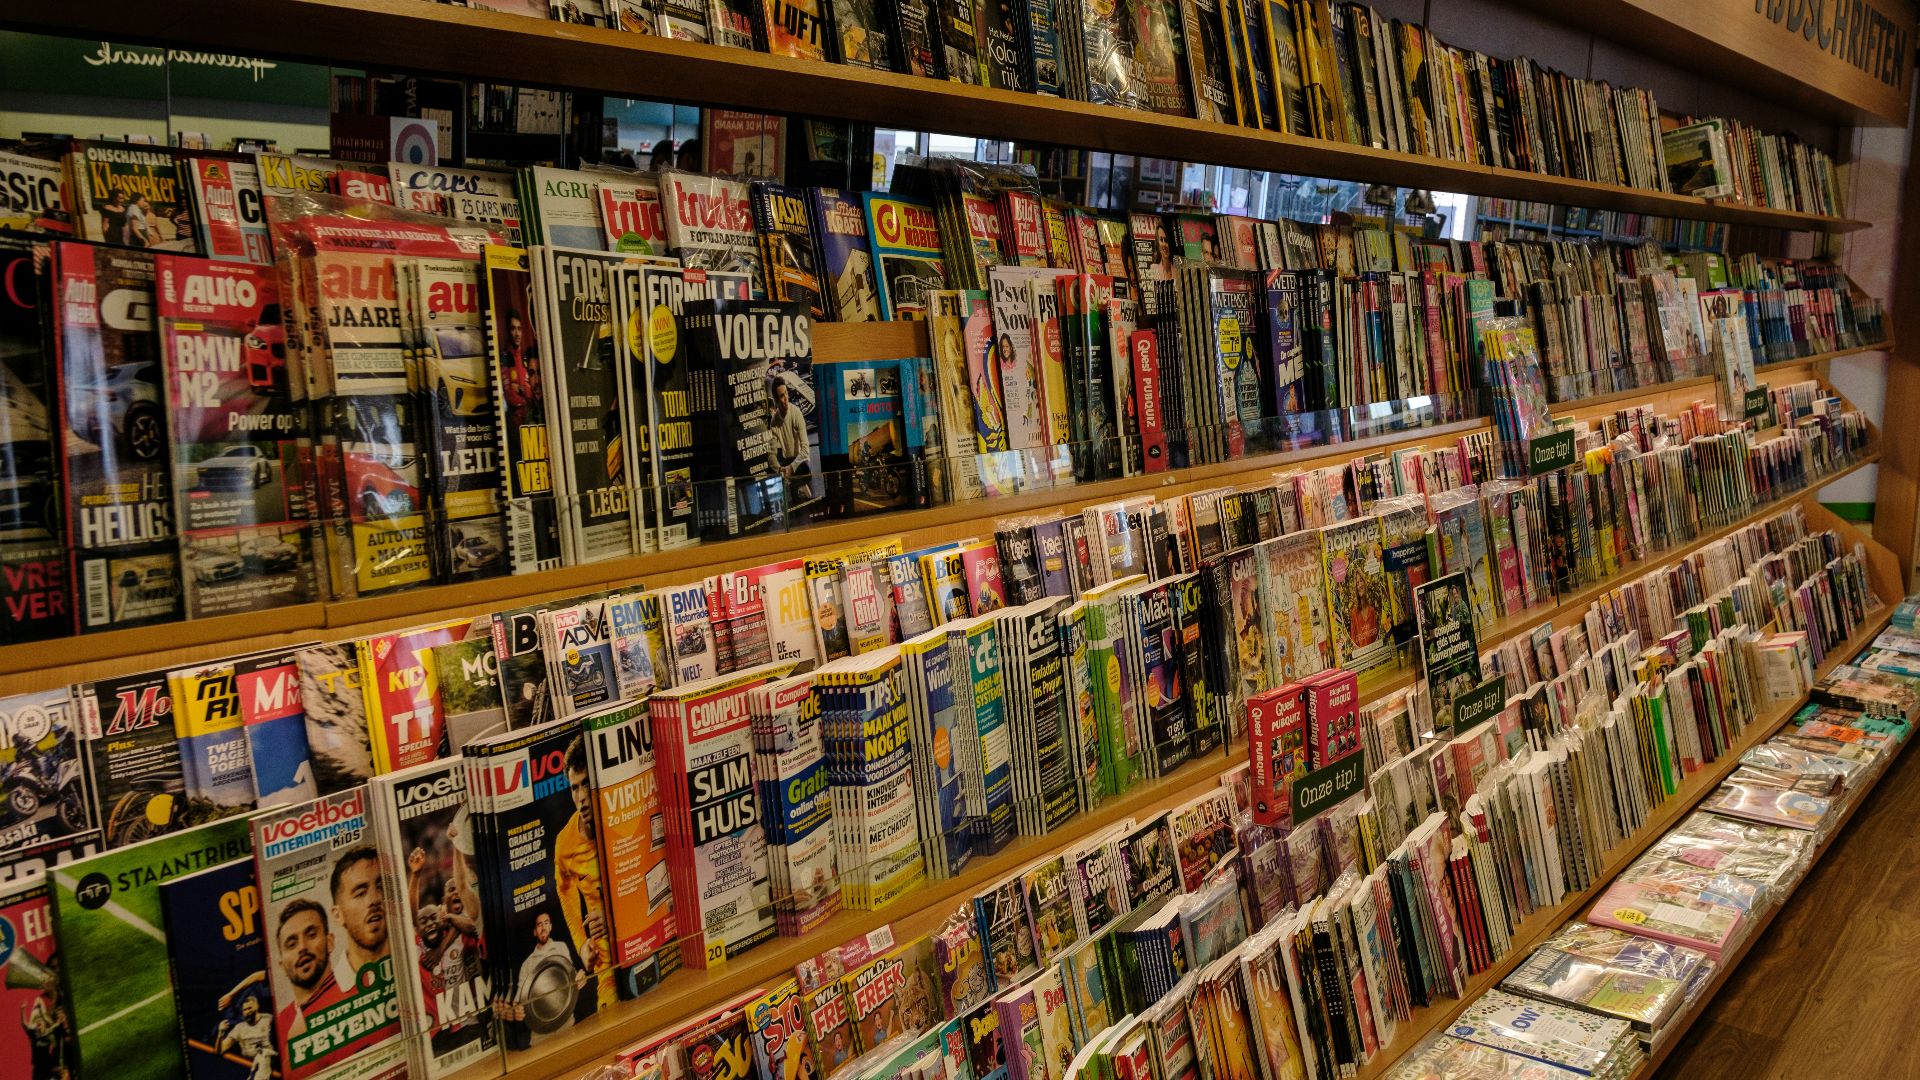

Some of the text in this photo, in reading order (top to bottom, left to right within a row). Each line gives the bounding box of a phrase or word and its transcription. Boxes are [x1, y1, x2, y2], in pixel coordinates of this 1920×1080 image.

[87, 147, 173, 167] ONSCHATBARE
[408, 170, 484, 195] cars
[183, 274, 258, 308] Auto
[175, 334, 242, 372] BMW
[714, 313, 811, 360] VOLGAS
[179, 370, 223, 408] M2
[228, 411, 276, 432] Power
[1534, 445, 1556, 464] Onze
[849, 567, 876, 598] BIKE
[594, 712, 624, 729] ALLES
[1274, 698, 1296, 718] Quest
[1459, 691, 1501, 723] Onze tip!
[391, 705, 434, 745] TT
[865, 737, 893, 761] NOG
[694, 758, 750, 802] SLIM
[1299, 762, 1358, 809] Onze tip!
[699, 793, 756, 842] HUIS
[854, 962, 906, 1020] FREEK
